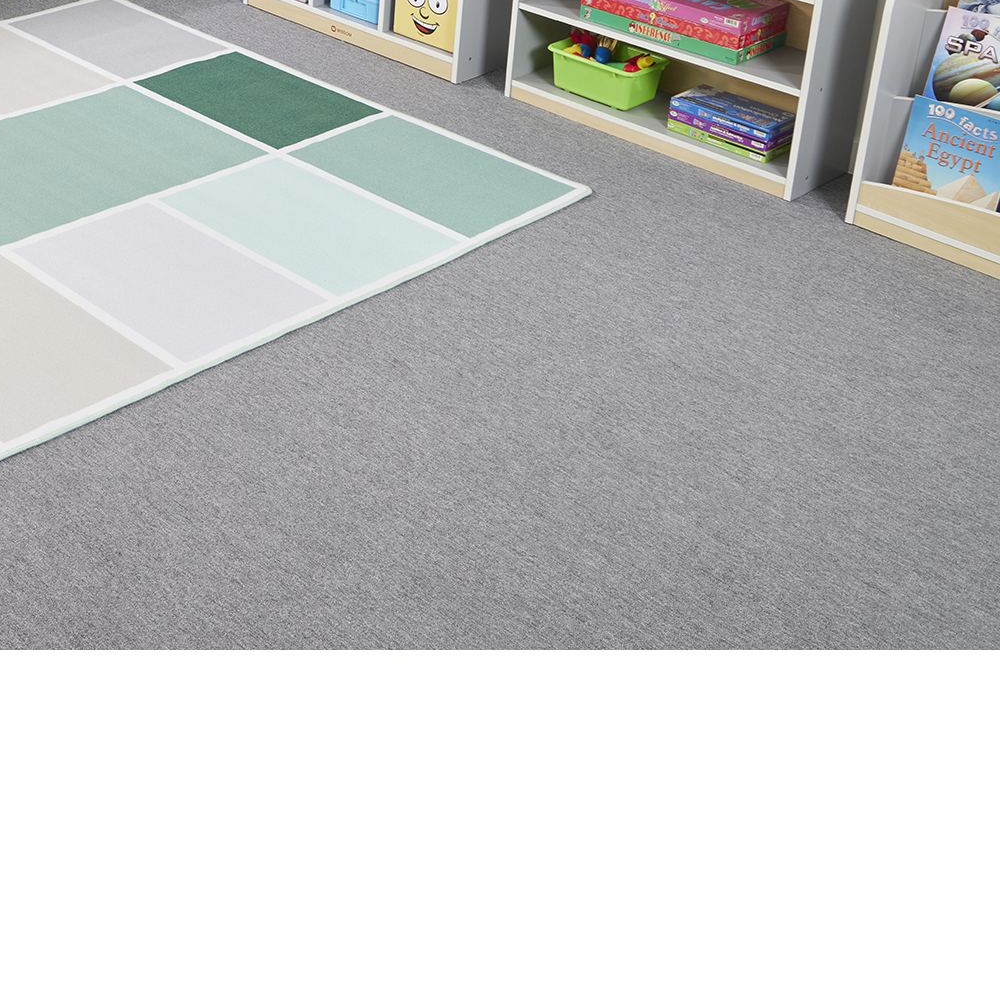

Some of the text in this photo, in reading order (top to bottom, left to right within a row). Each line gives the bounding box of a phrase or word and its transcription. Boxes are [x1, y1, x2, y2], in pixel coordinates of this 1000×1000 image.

[962, 14, 990, 29] 100
[945, 35, 998, 64] SPA
[928, 104, 998, 140] 100 facts
[922, 122, 996, 158] Ancient
[926, 141, 982, 174] Egypt
